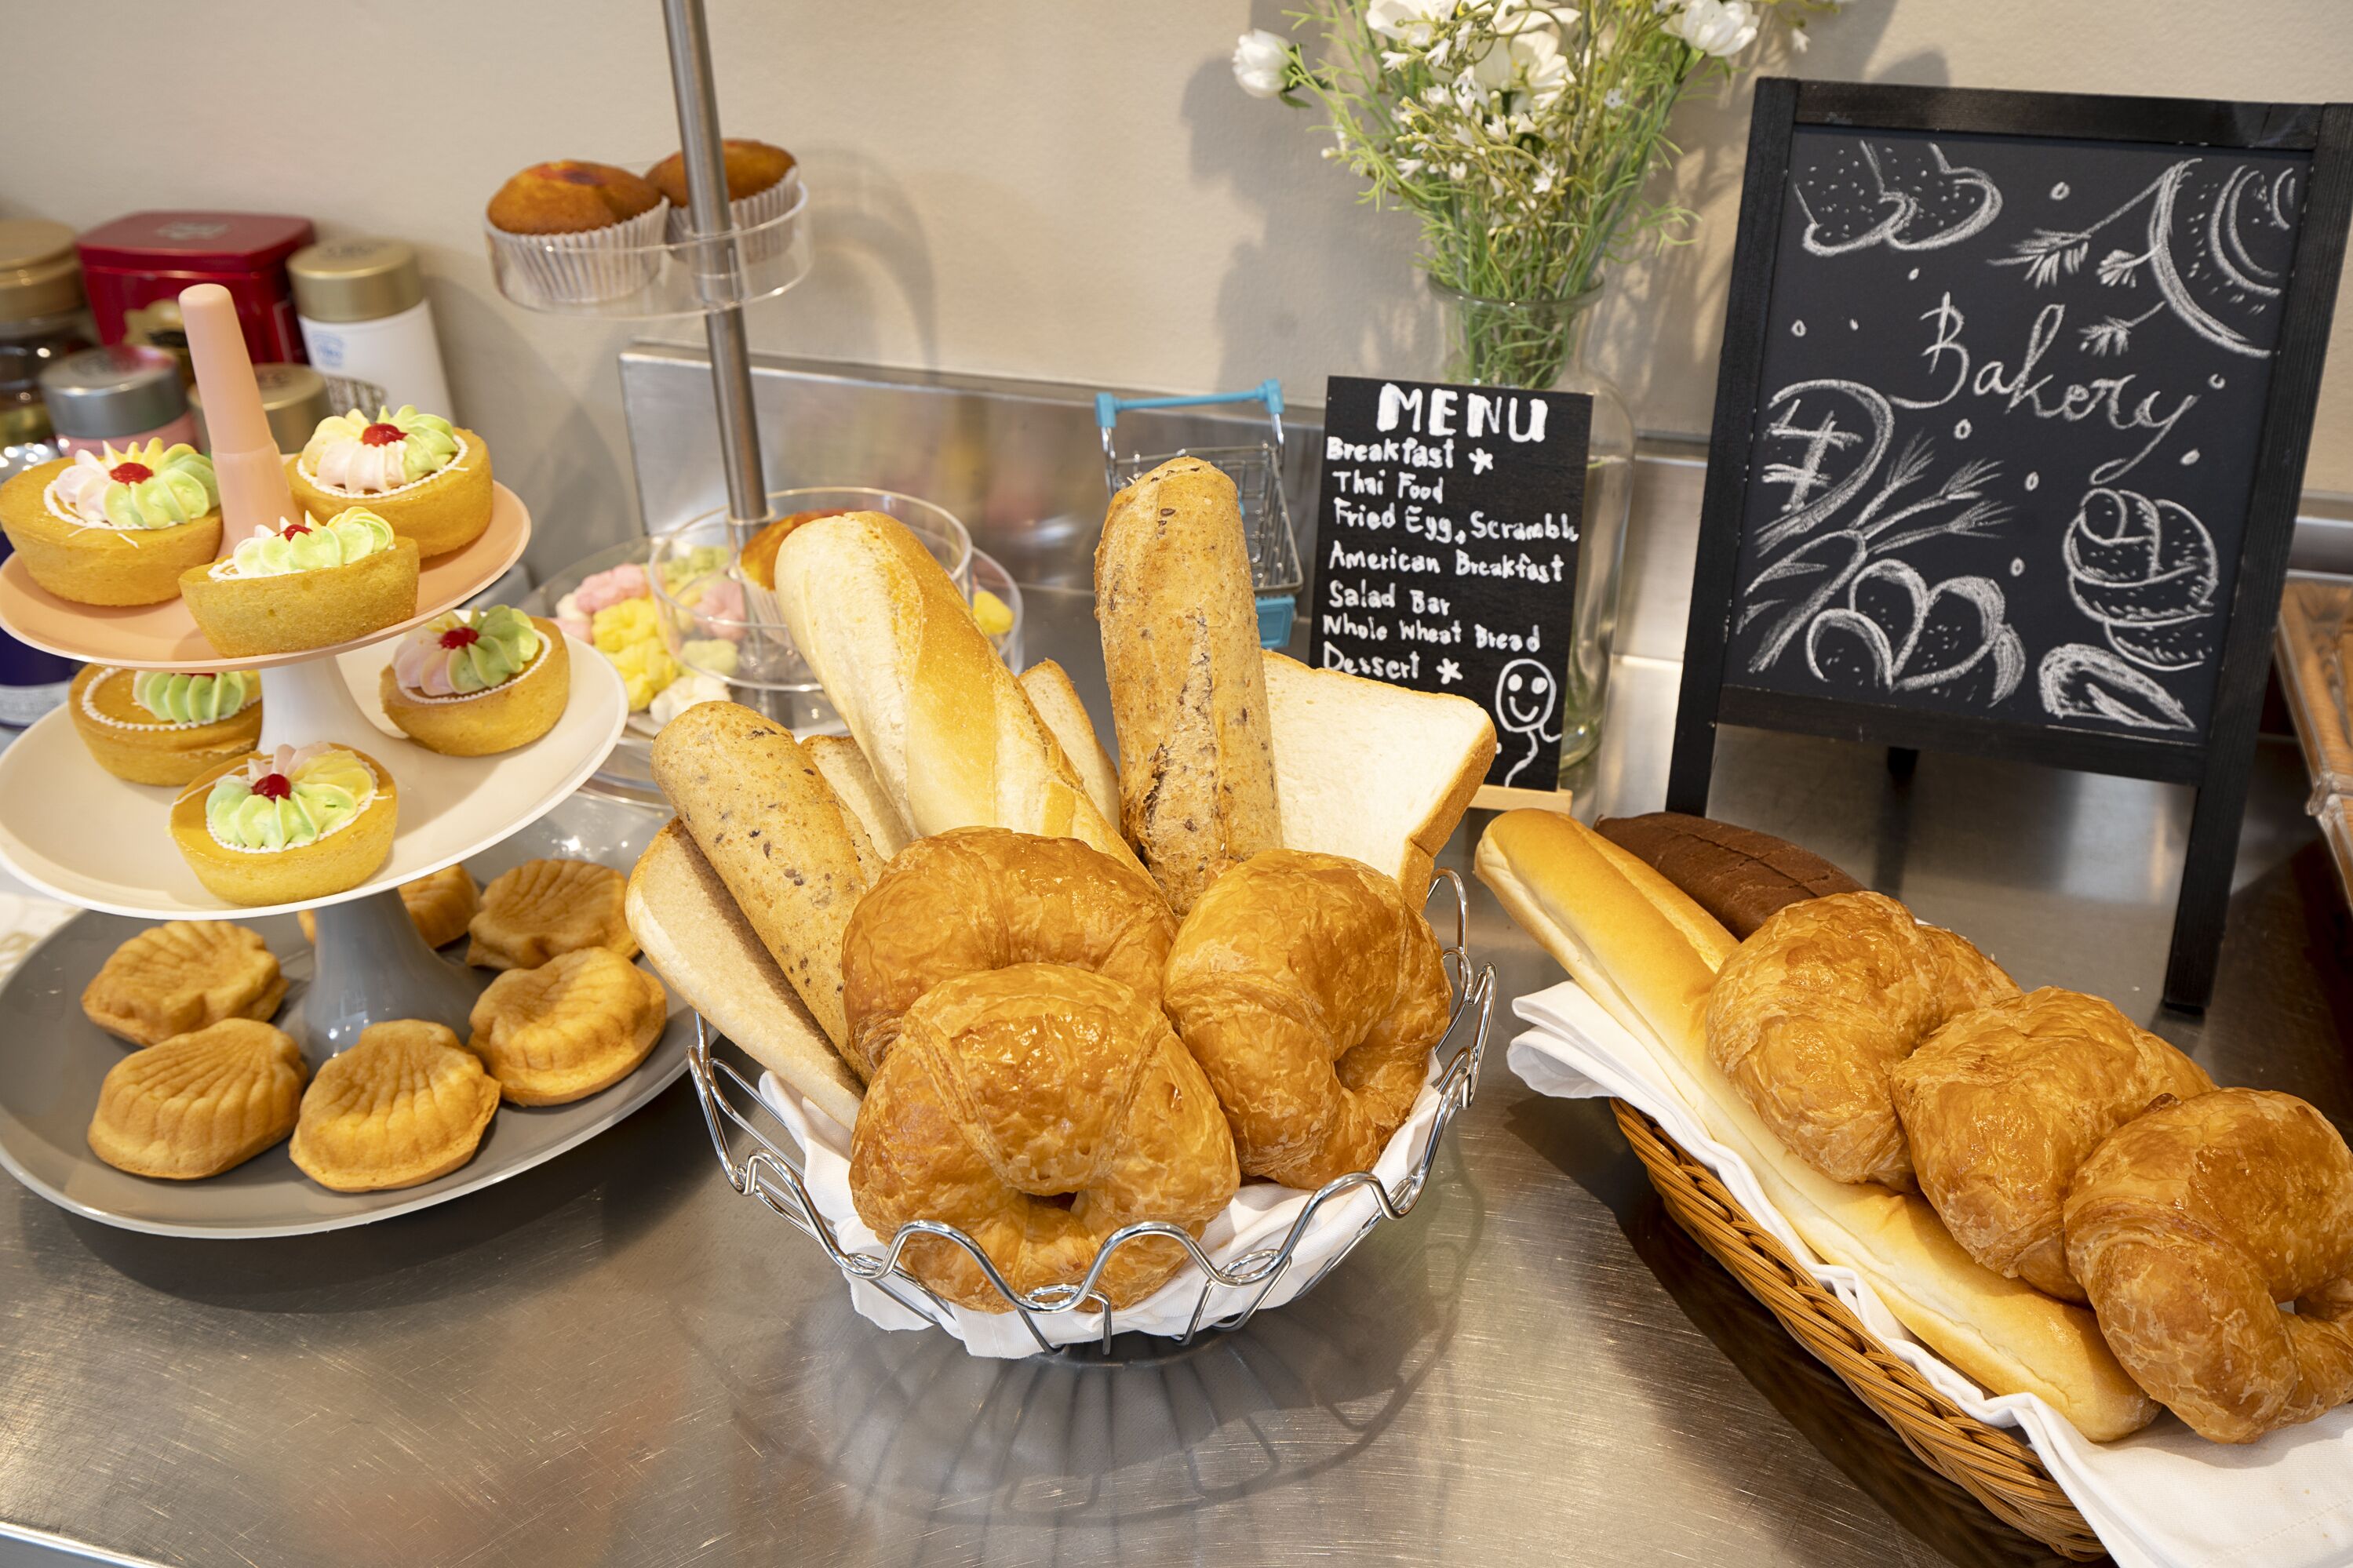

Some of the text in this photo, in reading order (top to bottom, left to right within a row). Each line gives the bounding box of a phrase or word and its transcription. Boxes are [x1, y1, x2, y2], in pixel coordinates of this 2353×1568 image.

[1889, 290, 2200, 486] Bakery
[1376, 382, 1549, 442] MENU
[1325, 435, 1455, 469] Breakfast
[1331, 468, 1444, 504] Thai Food
[1333, 497, 1397, 530] Fried
[1328, 540, 1565, 584] American Breakfast
[1328, 578, 1451, 617] Salad Bar
[1398, 619, 1462, 645] Wheat
[1473, 623, 1541, 653] Bread
[1322, 641, 1421, 680] Dessert
